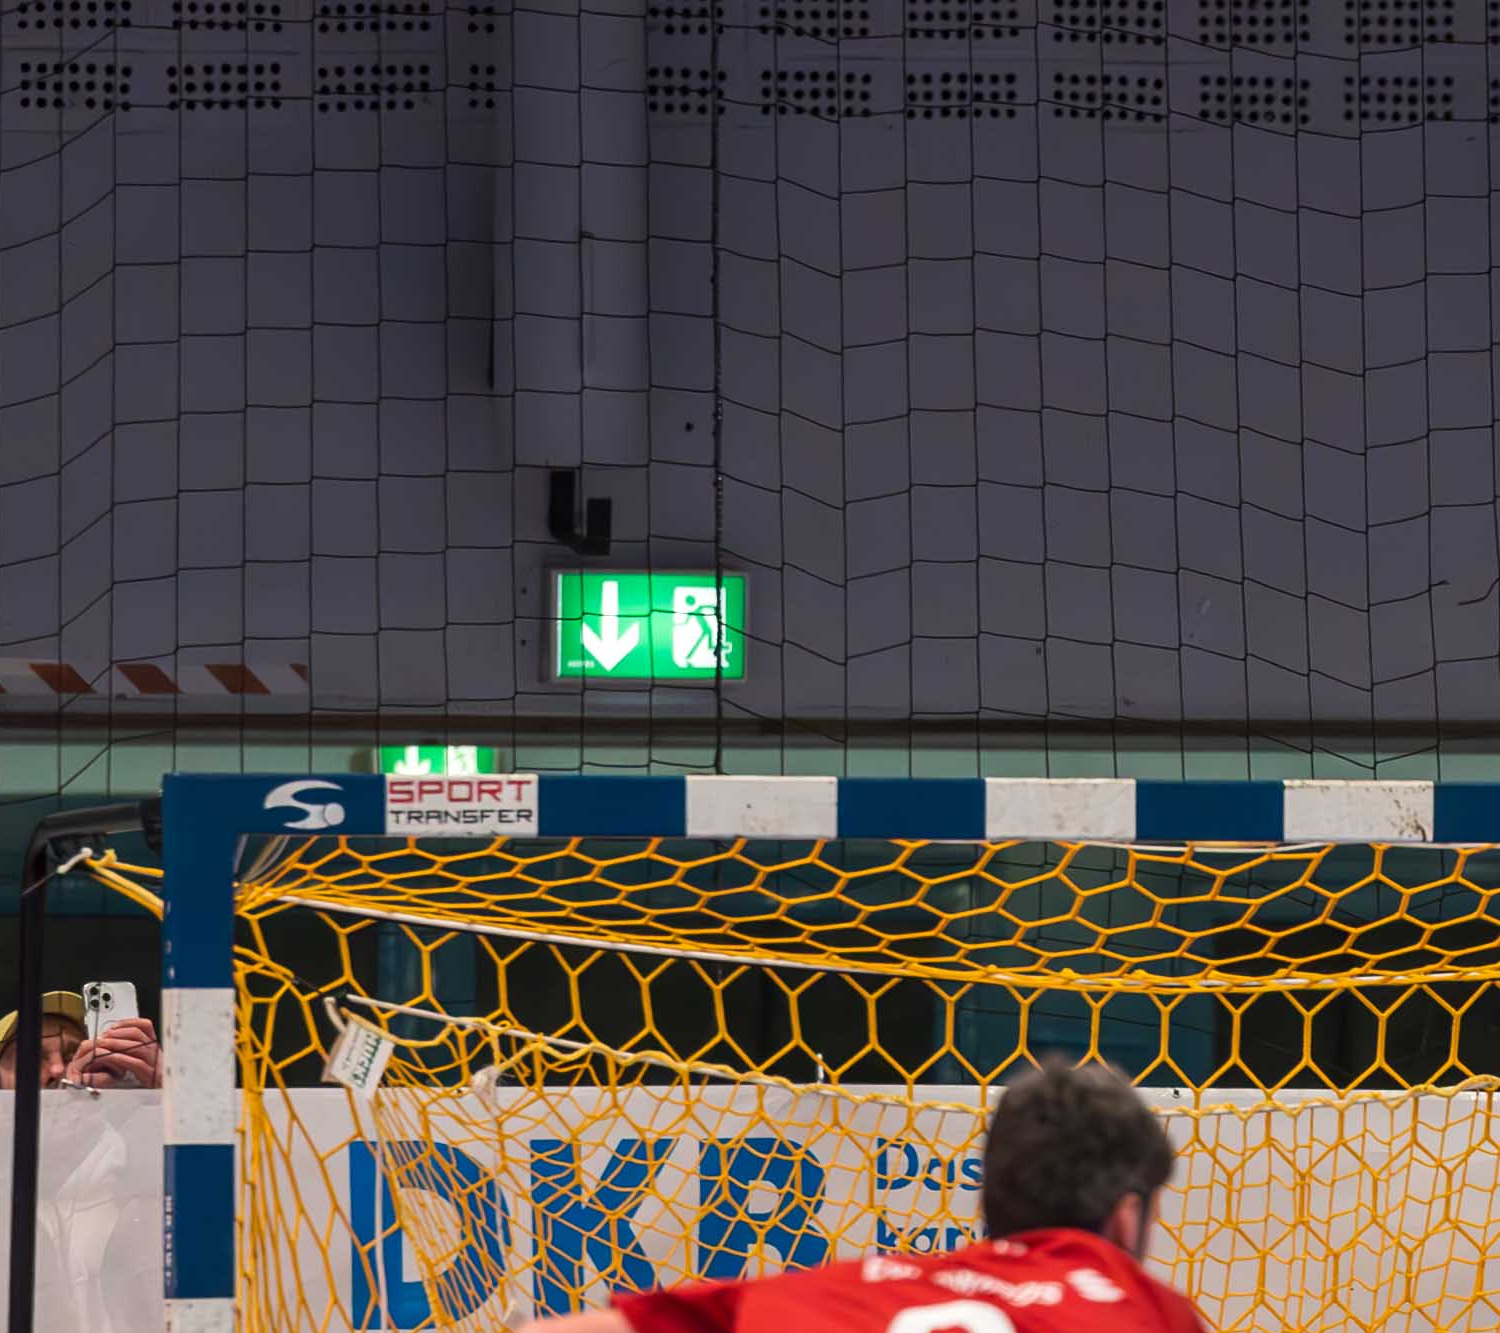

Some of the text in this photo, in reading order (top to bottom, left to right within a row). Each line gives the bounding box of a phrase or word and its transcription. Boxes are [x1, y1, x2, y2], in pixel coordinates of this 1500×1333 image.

[389, 780, 533, 803] SPORT
[390, 809, 534, 825] TRANSFER
[876, 1136, 985, 1191] Das
[348, 1137, 830, 1331] DKB
[876, 1208, 990, 1256] kan
